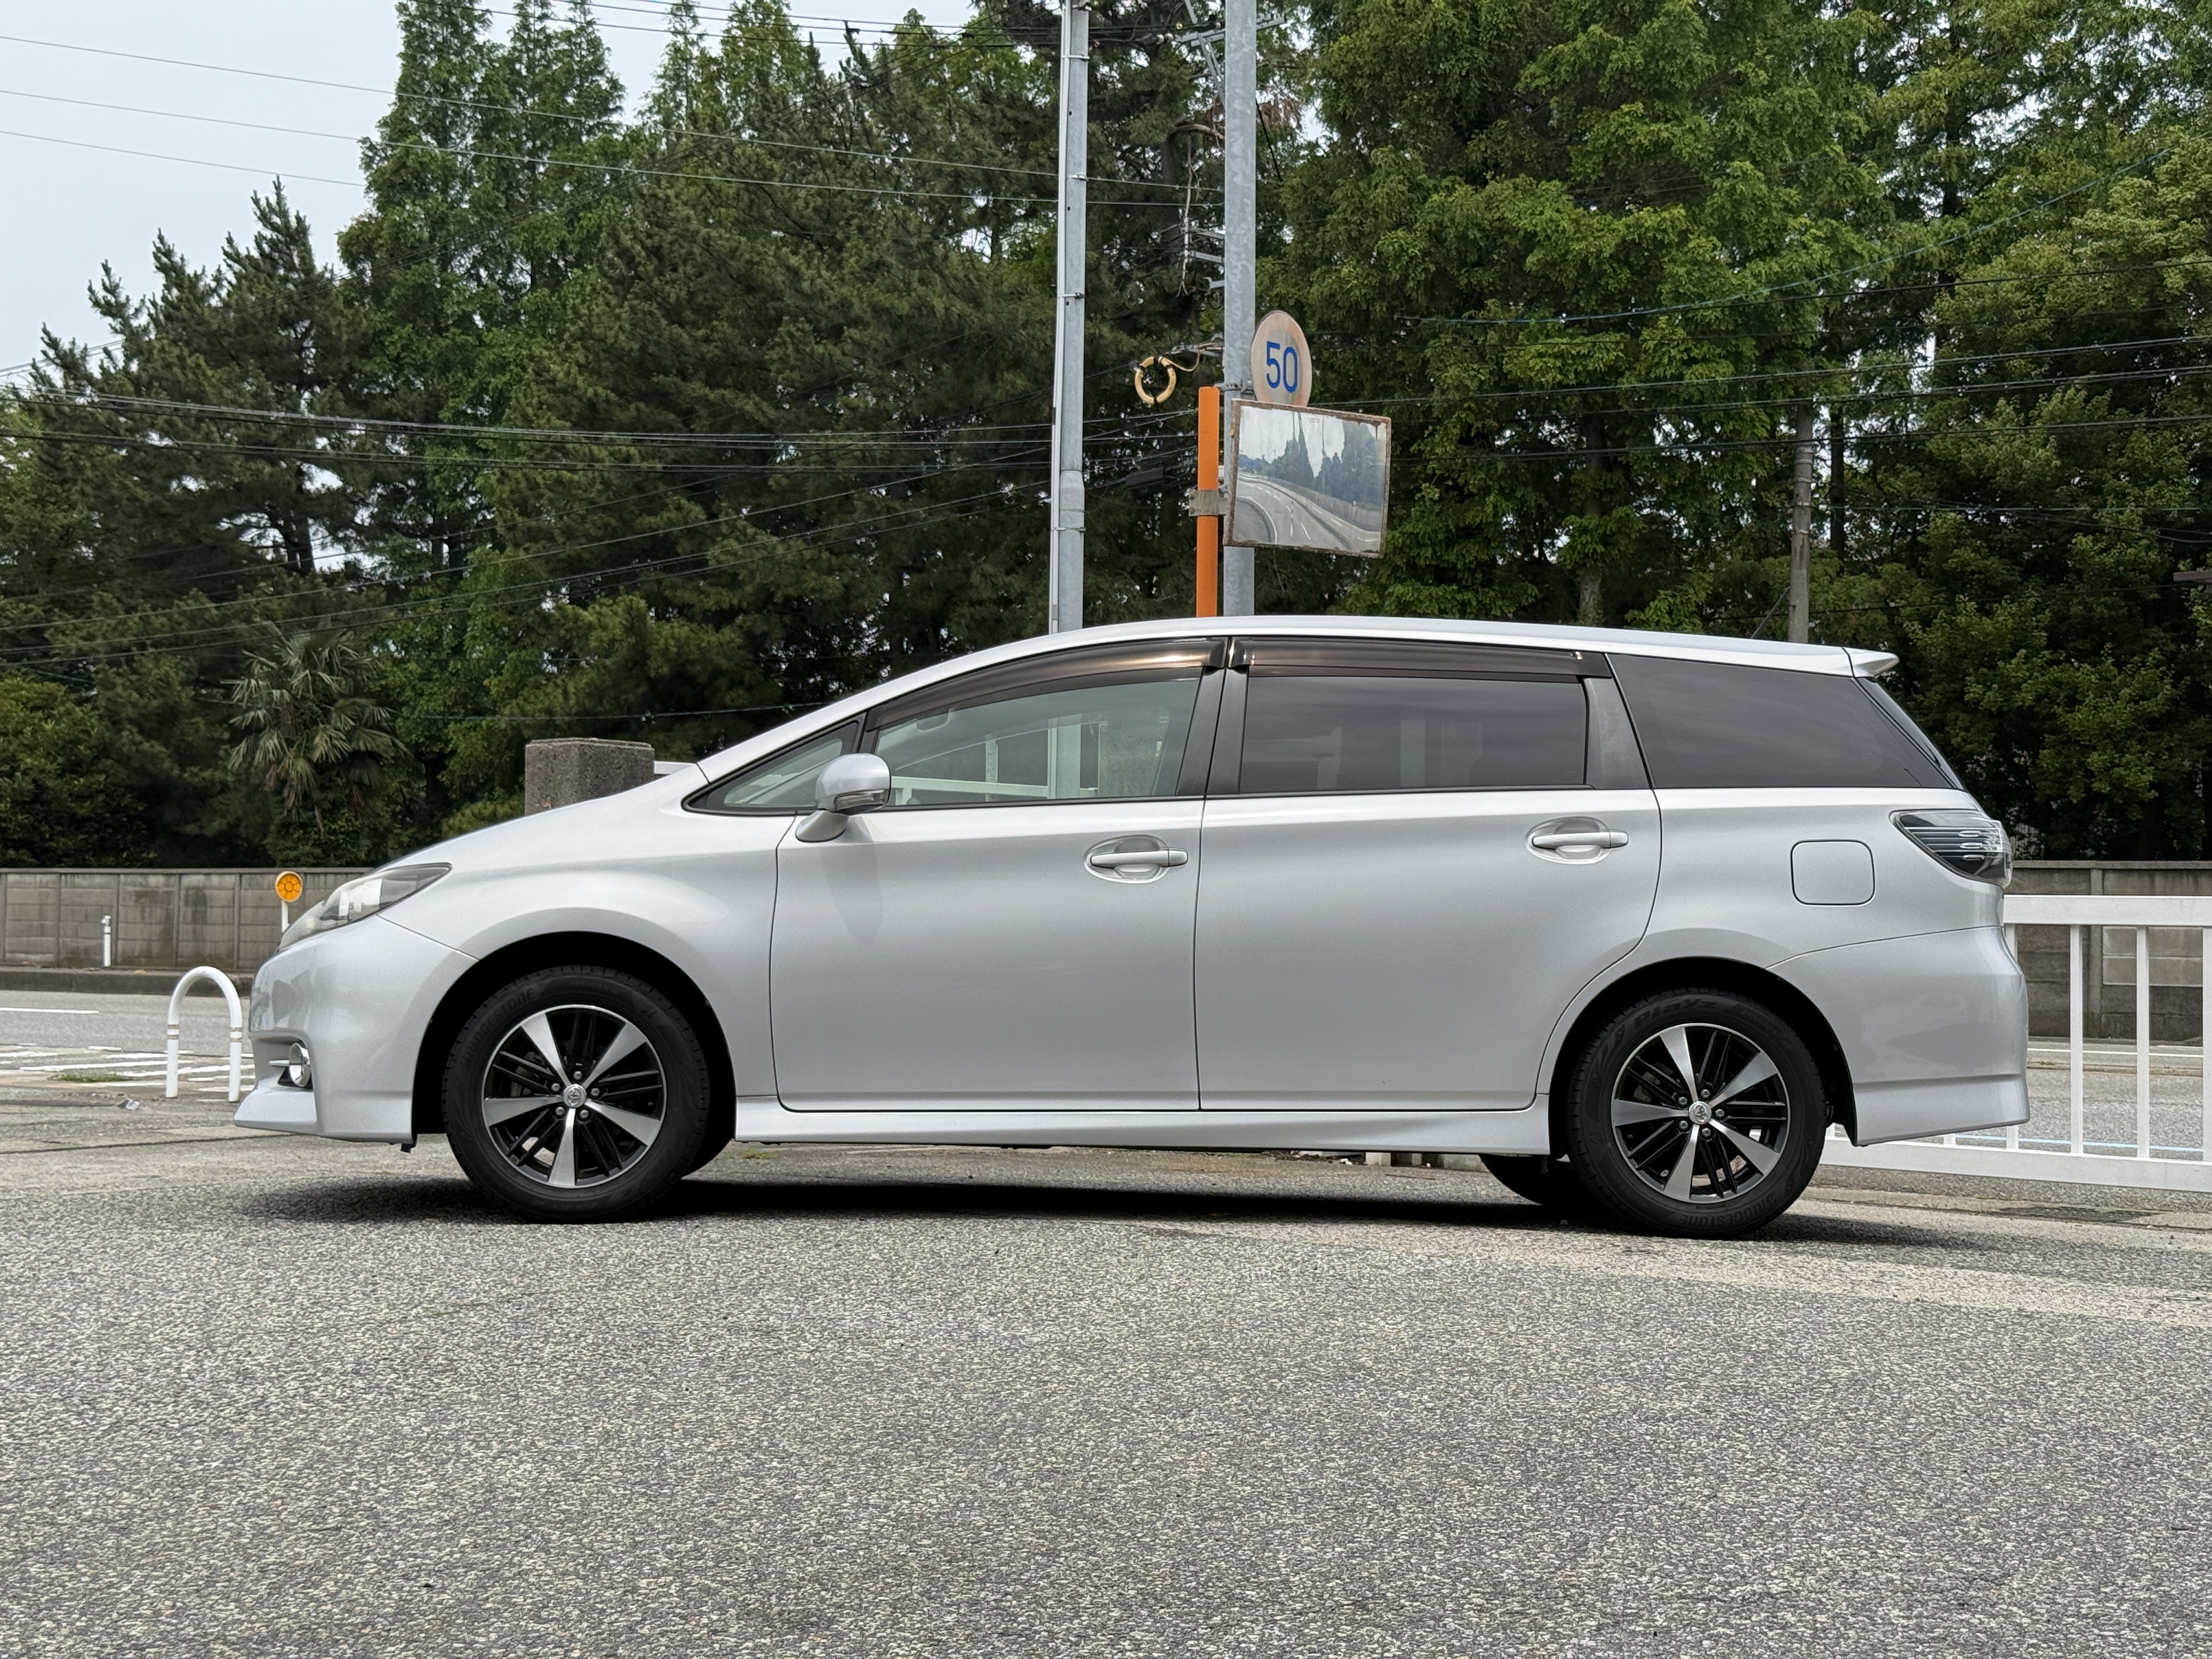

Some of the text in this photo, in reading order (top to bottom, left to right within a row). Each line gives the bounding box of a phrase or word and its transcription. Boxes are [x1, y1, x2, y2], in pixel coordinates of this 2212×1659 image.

[1267, 341, 1298, 393] 50
[462, 986, 537, 1069] BRIDGESTONE
[1678, 1193, 1779, 1231] BRIDGESTONE
